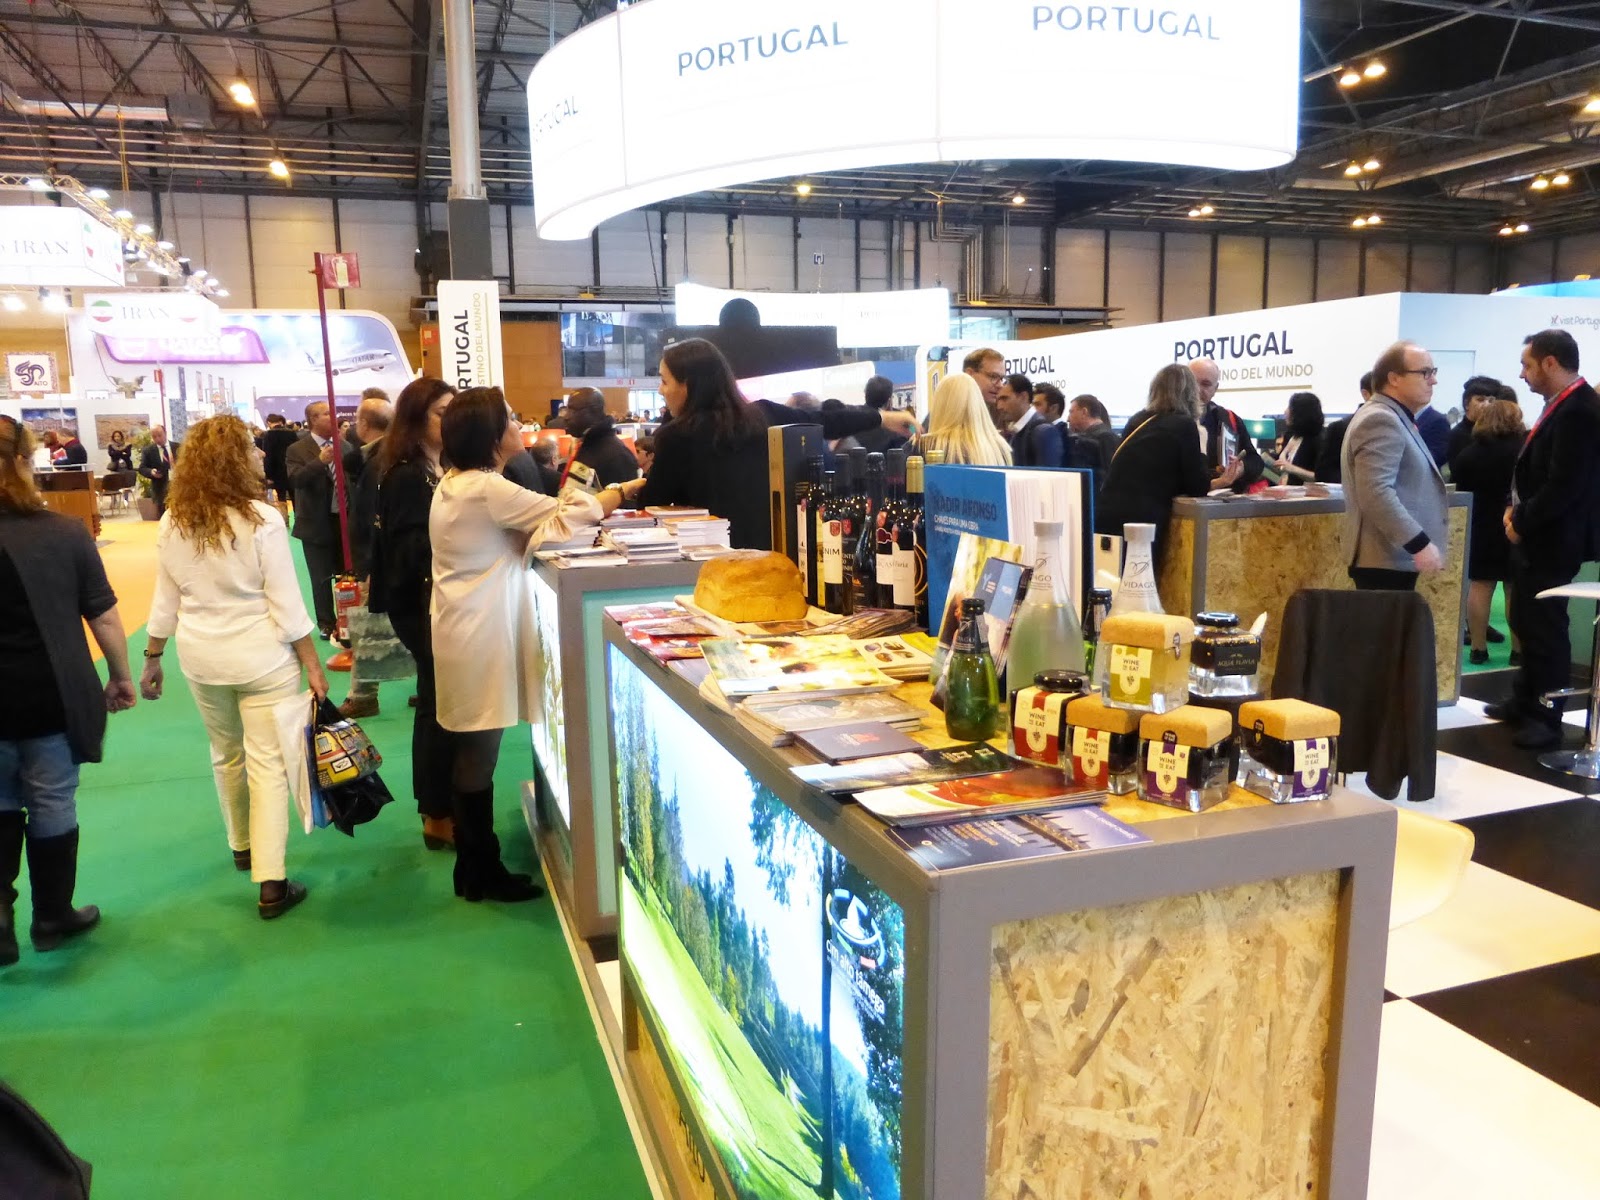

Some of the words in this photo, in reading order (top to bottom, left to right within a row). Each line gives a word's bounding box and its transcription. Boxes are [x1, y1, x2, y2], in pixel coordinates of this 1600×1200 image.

[1032, 5, 1220, 40] PORTUGAL
[678, 21, 848, 77] PORTUGAL
[14, 239, 71, 254] IRAN
[121, 306, 170, 320] IRAN
[472, 292, 482, 331] MUNDO
[475, 334, 484, 353] DEL
[1174, 330, 1294, 361] PORTUGAL
[1241, 367, 1263, 380] DEL
[1265, 363, 1314, 378] MUNDO
[1123, 658, 1139, 666] WINE
[1029, 712, 1046, 721] WINE
[1035, 720, 1046, 728] EAT
[1083, 741, 1099, 750] WINE
[1159, 756, 1176, 765] WINE
[1304, 752, 1320, 760] WINE
